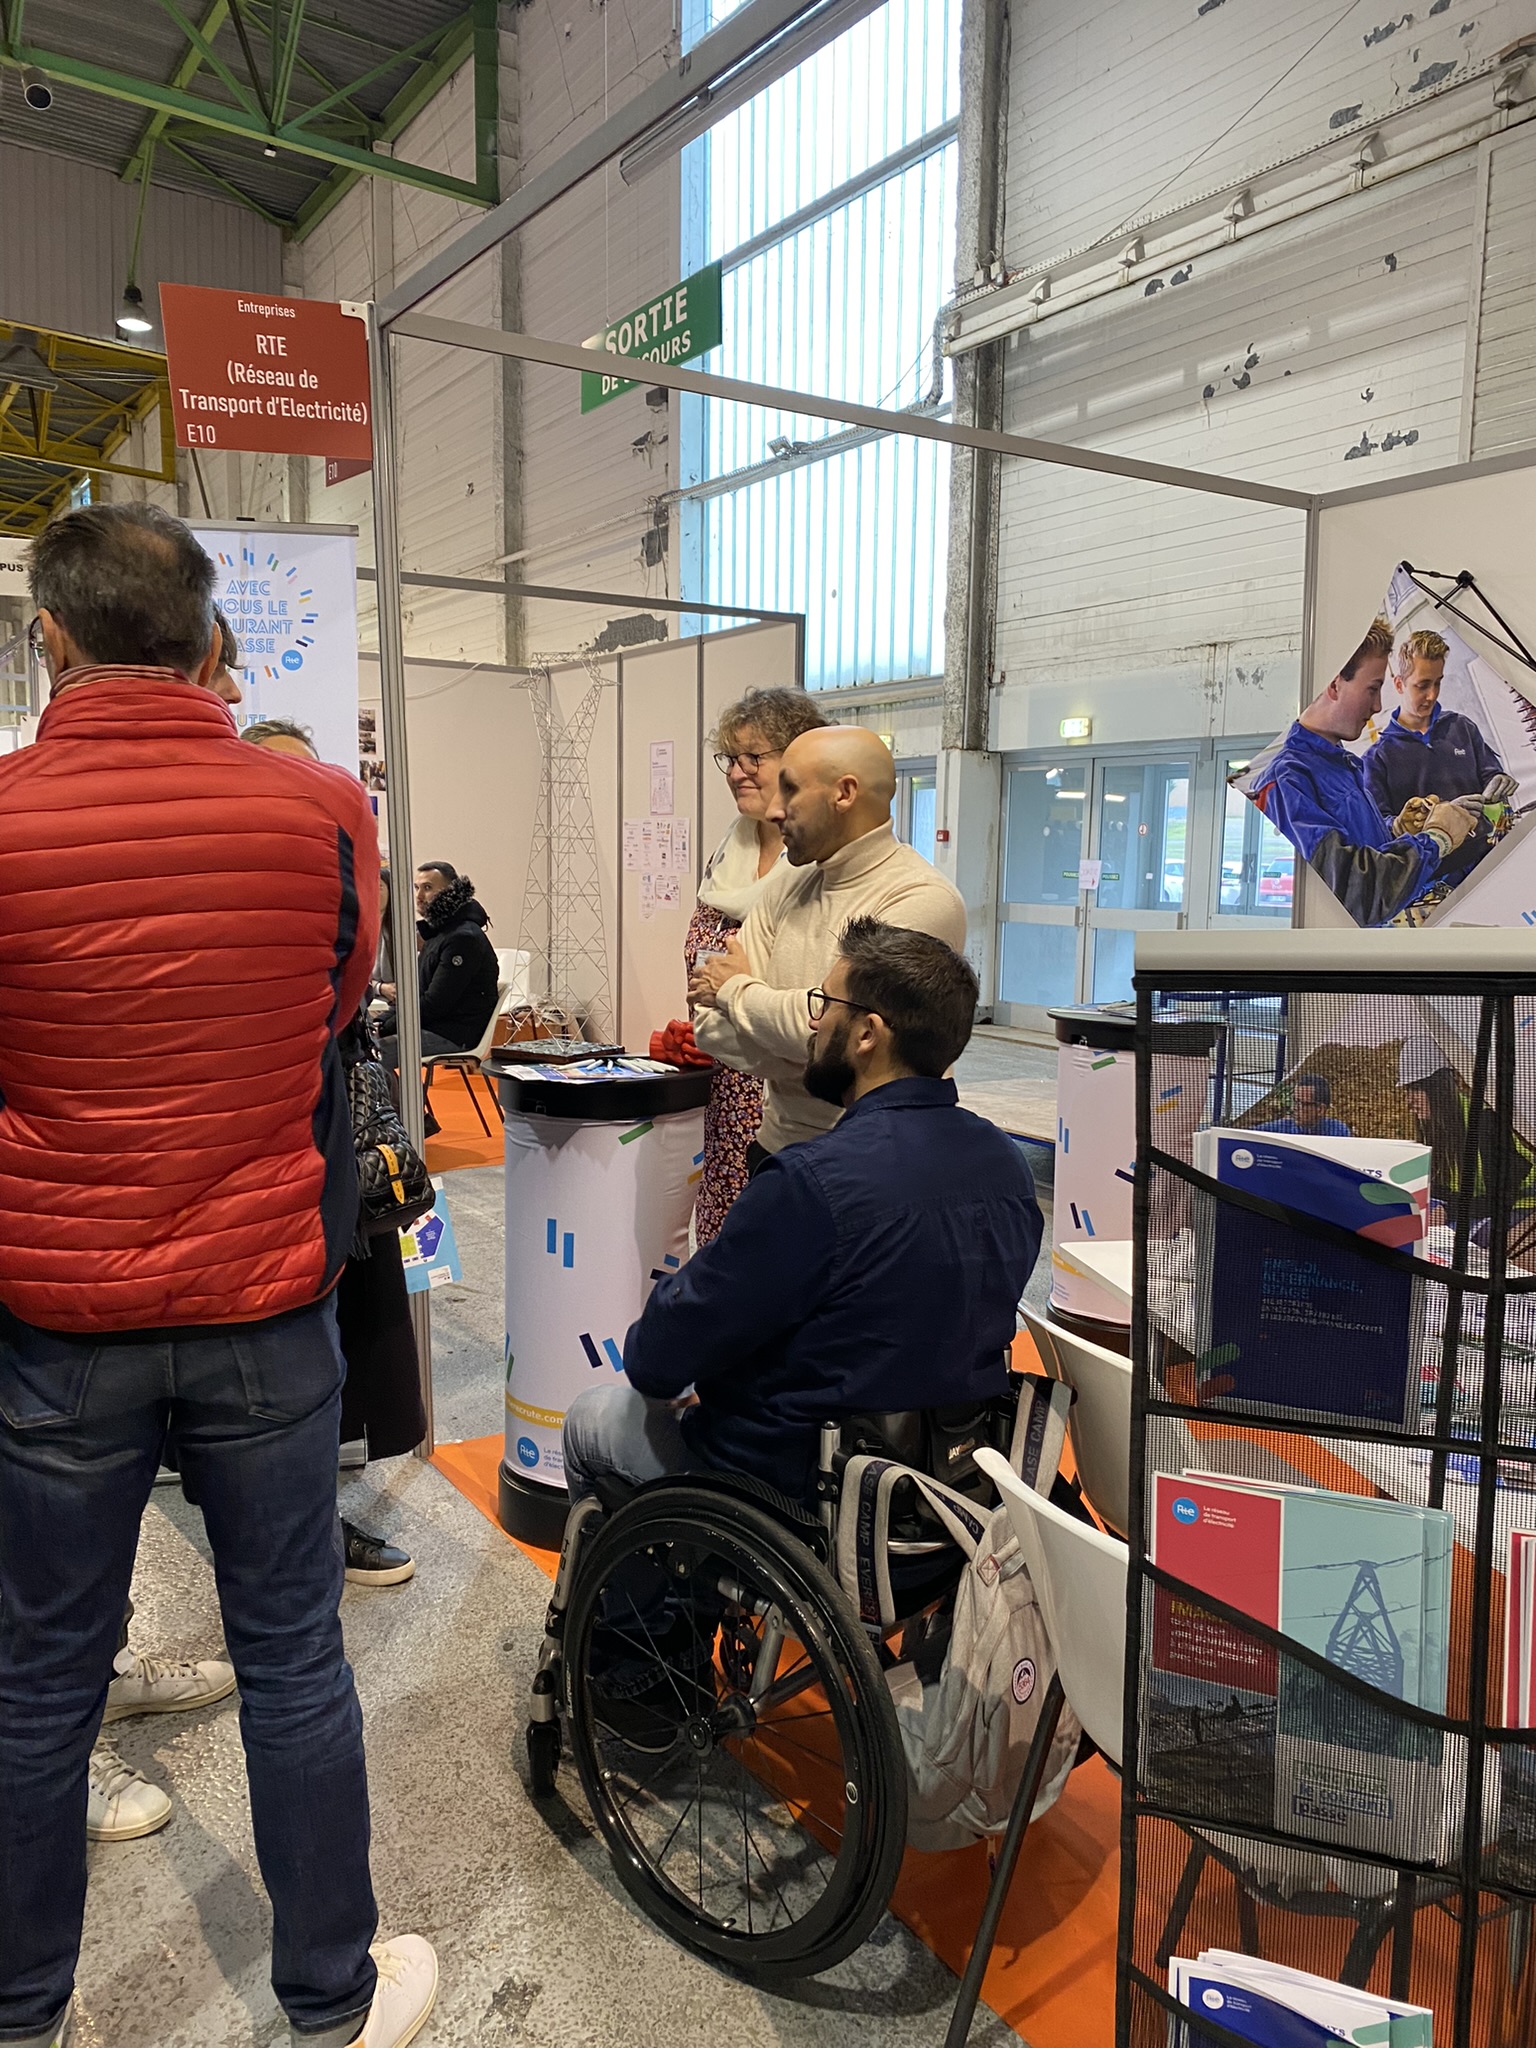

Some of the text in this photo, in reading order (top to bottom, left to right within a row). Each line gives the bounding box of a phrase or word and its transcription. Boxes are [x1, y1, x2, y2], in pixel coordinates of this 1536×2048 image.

[237, 299, 296, 318] Entreprises
[605, 287, 688, 355] SORTIE
[256, 333, 288, 357] RTE
[227, 360, 318, 389] (Réseau de
[602, 375, 618, 395] DE
[179, 388, 368, 425] Transport d'Electricité)
[186, 423, 216, 444] E10
[226, 580, 271, 596] AVEC
[268, 600, 288, 616] LE
[228, 618, 293, 635] URANT
[236, 637, 275, 654] ASSE
[285, 656, 300, 665] Rte
[236, 714, 267, 727] UTE
[1030, 1401, 1046, 1442] CAMP
[520, 1444, 535, 1460] Rte
[864, 1464, 878, 1497] ASE
[1176, 1504, 1195, 1517] Rte
[859, 1501, 872, 1546] CAMP
